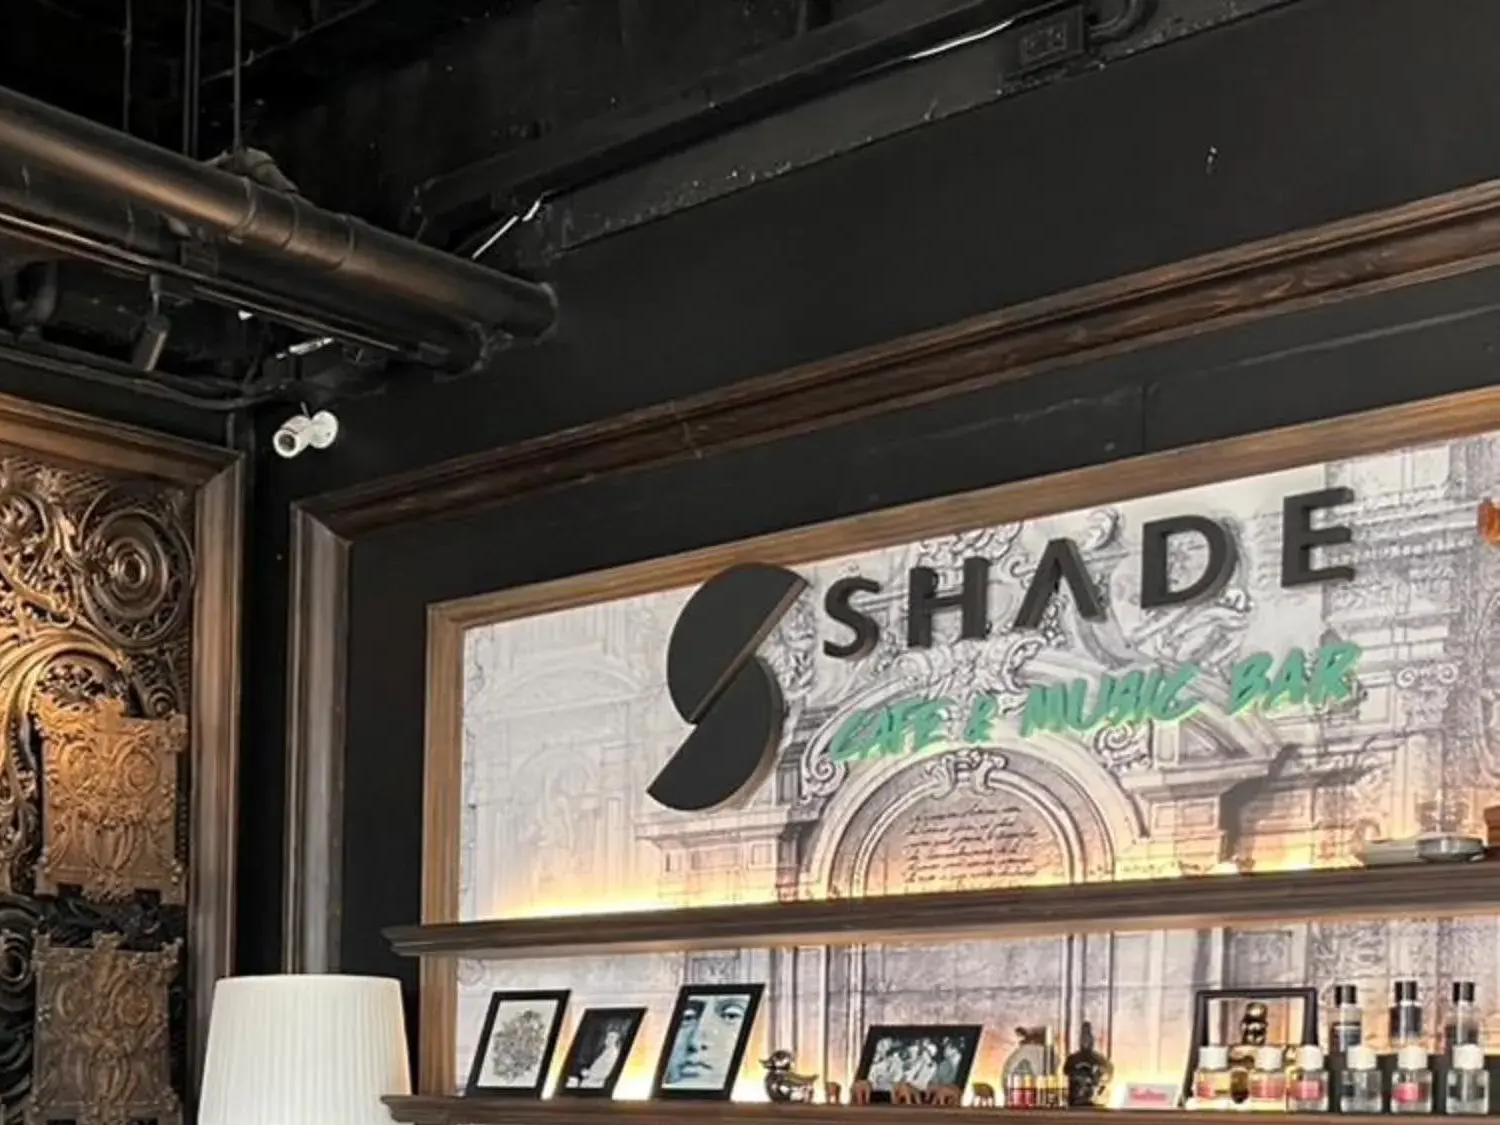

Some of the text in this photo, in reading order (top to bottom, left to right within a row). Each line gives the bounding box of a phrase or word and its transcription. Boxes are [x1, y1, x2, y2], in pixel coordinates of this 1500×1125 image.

[823, 487, 1356, 660] SHADE
[1020, 658, 1200, 740] MUSIC
[1230, 641, 1362, 716] BAR
